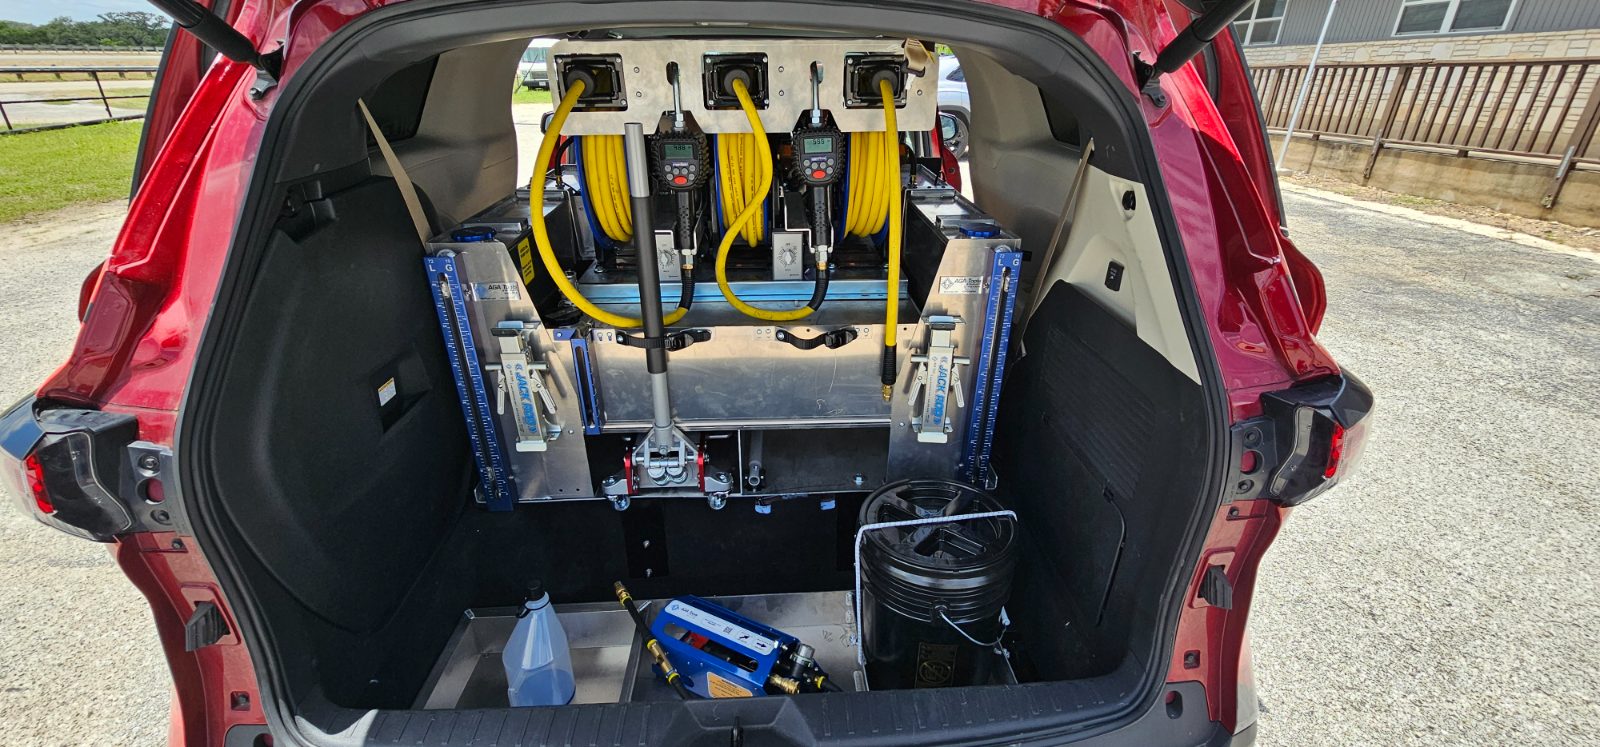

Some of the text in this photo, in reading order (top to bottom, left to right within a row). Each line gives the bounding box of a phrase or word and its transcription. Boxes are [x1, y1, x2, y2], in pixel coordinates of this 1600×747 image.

[428, 263, 454, 272] L G
[998, 258, 1020, 266] L G
[515, 372, 532, 403] JACK
[936, 364, 948, 395] JACK
